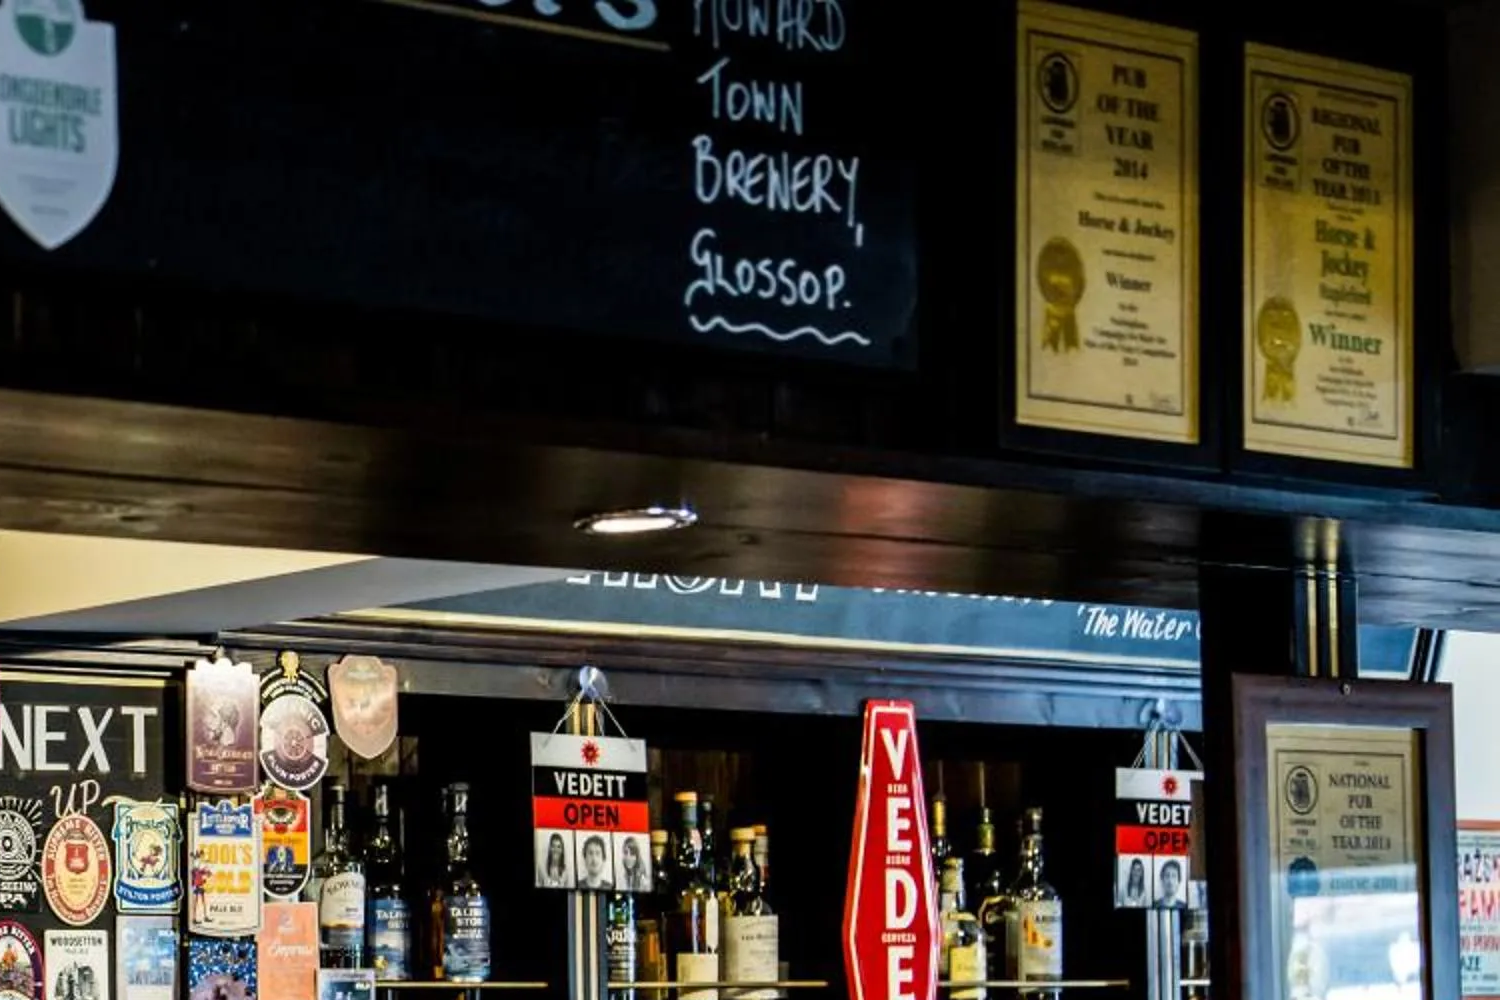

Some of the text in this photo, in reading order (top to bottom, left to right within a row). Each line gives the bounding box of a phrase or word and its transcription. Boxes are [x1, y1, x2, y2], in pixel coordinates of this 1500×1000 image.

[1112, 64, 1147, 89] PUB
[698, 58, 803, 136] TOWN
[1097, 94, 1161, 123] OF THE
[8, 106, 86, 154] LIGHTS
[1105, 124, 1154, 151] YEAR
[1333, 134, 1361, 156] PUB
[1322, 157, 1371, 181] OF THE
[1105, 271, 1152, 293] Winner
[1308, 322, 1384, 356] Winner
[1122, 609, 1192, 641] Water
[553, 771, 627, 799] VEDETT
[1328, 773, 1392, 790] NATIONAL
[1136, 802, 1191, 826] VEDET
[1348, 794, 1373, 810] PUB
[563, 803, 620, 827] OPEN
[1339, 815, 1384, 831] OF THE
[1332, 835, 1363, 850] YEAR
